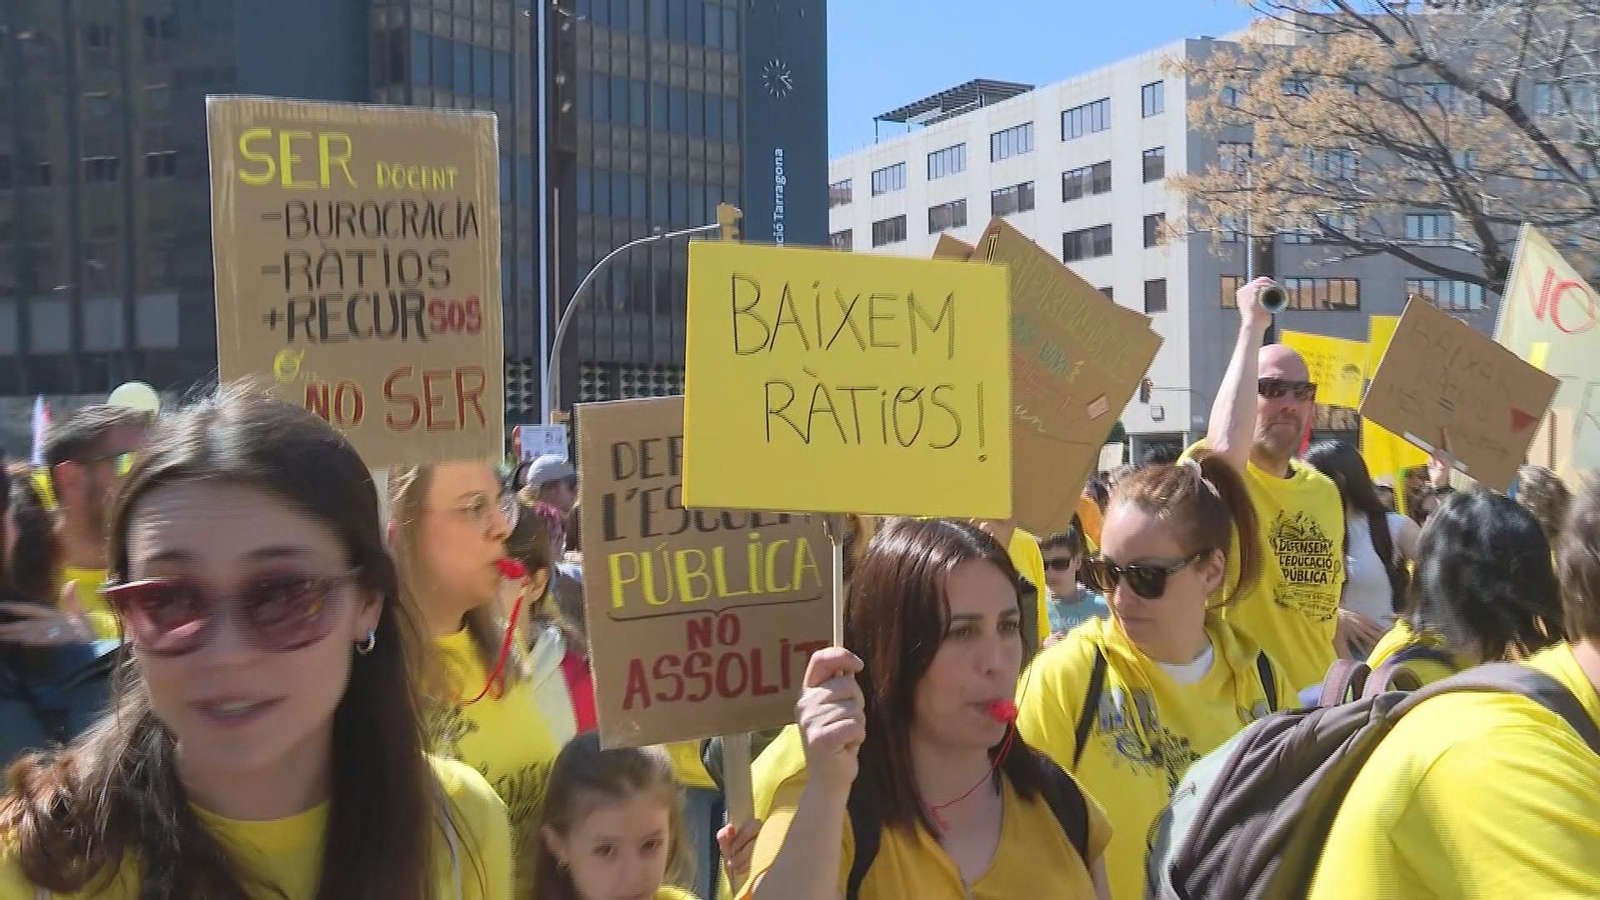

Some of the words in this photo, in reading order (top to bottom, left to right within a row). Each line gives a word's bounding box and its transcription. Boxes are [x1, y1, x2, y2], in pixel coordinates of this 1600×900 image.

[238, 127, 358, 190] SER
[773, 147, 786, 221] Tarragona
[772, 223, 784, 247] ció
[303, 379, 365, 427] NO
[382, 365, 486, 432] SER
[1279, 540, 1328, 553] DEFENSEM
[1281, 567, 1328, 584] PÚBLICA
[686, 613, 741, 650] NO
